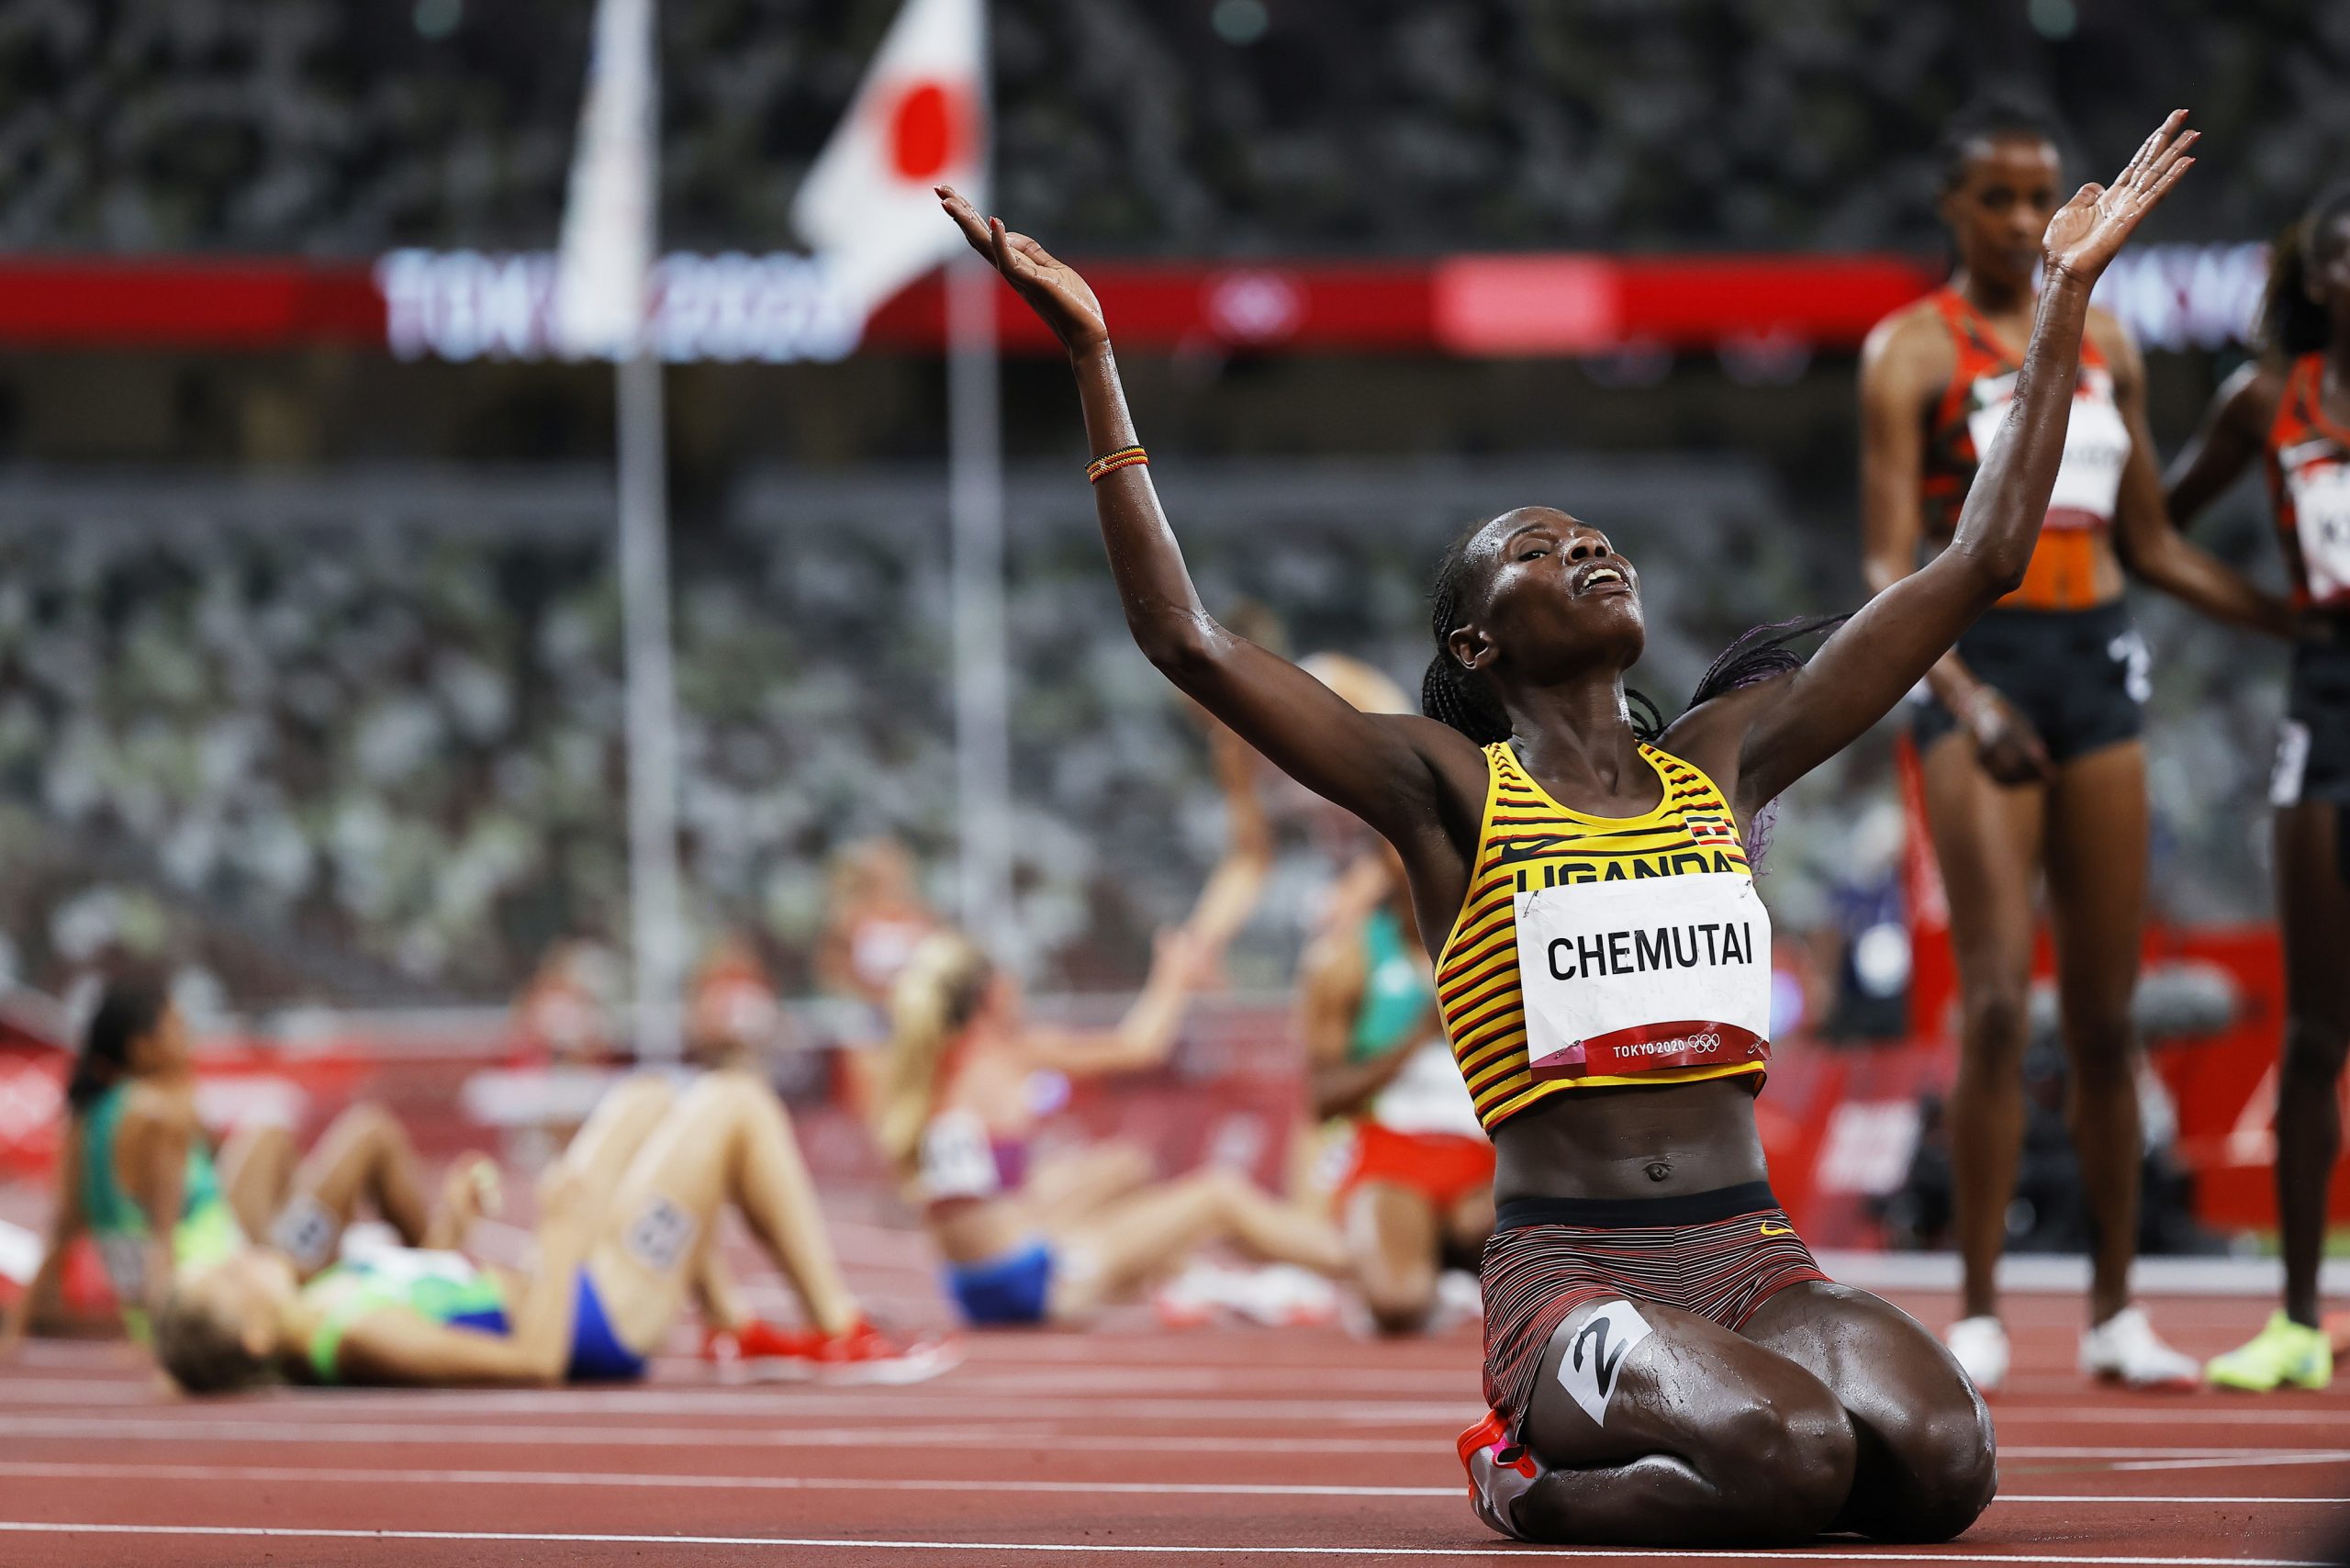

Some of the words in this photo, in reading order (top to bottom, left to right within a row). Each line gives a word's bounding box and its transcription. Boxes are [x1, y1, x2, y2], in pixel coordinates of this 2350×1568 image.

[1547, 922, 1753, 980] CHEMUTAI
[1613, 1042, 1654, 1058] TOKYO
[1656, 1039, 1685, 1054] 2020
[1572, 1316, 1628, 1399] 2
